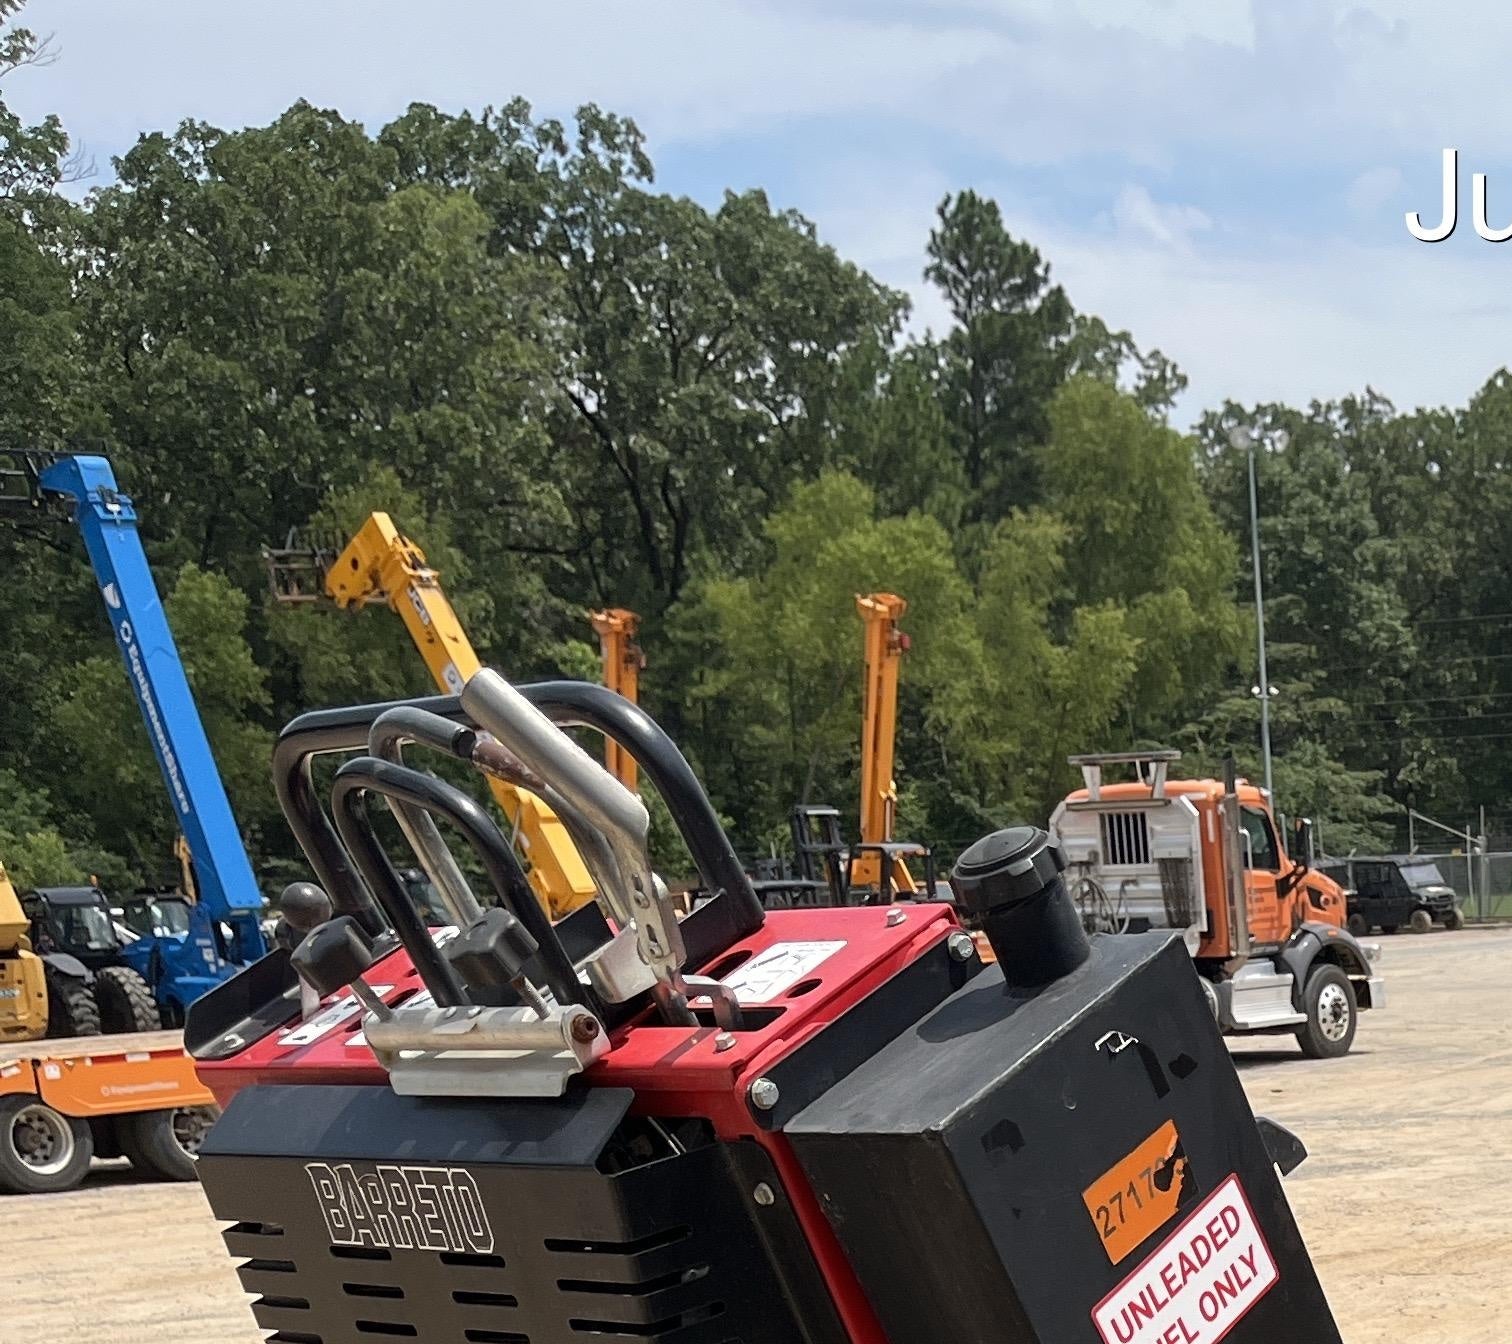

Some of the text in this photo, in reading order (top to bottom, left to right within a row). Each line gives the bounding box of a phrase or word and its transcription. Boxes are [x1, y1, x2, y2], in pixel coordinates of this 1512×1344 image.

[303, 1162, 495, 1254] BARRETO
[1110, 1204, 1241, 1344] UNLEADED
[1198, 1244, 1260, 1323] ONLY
